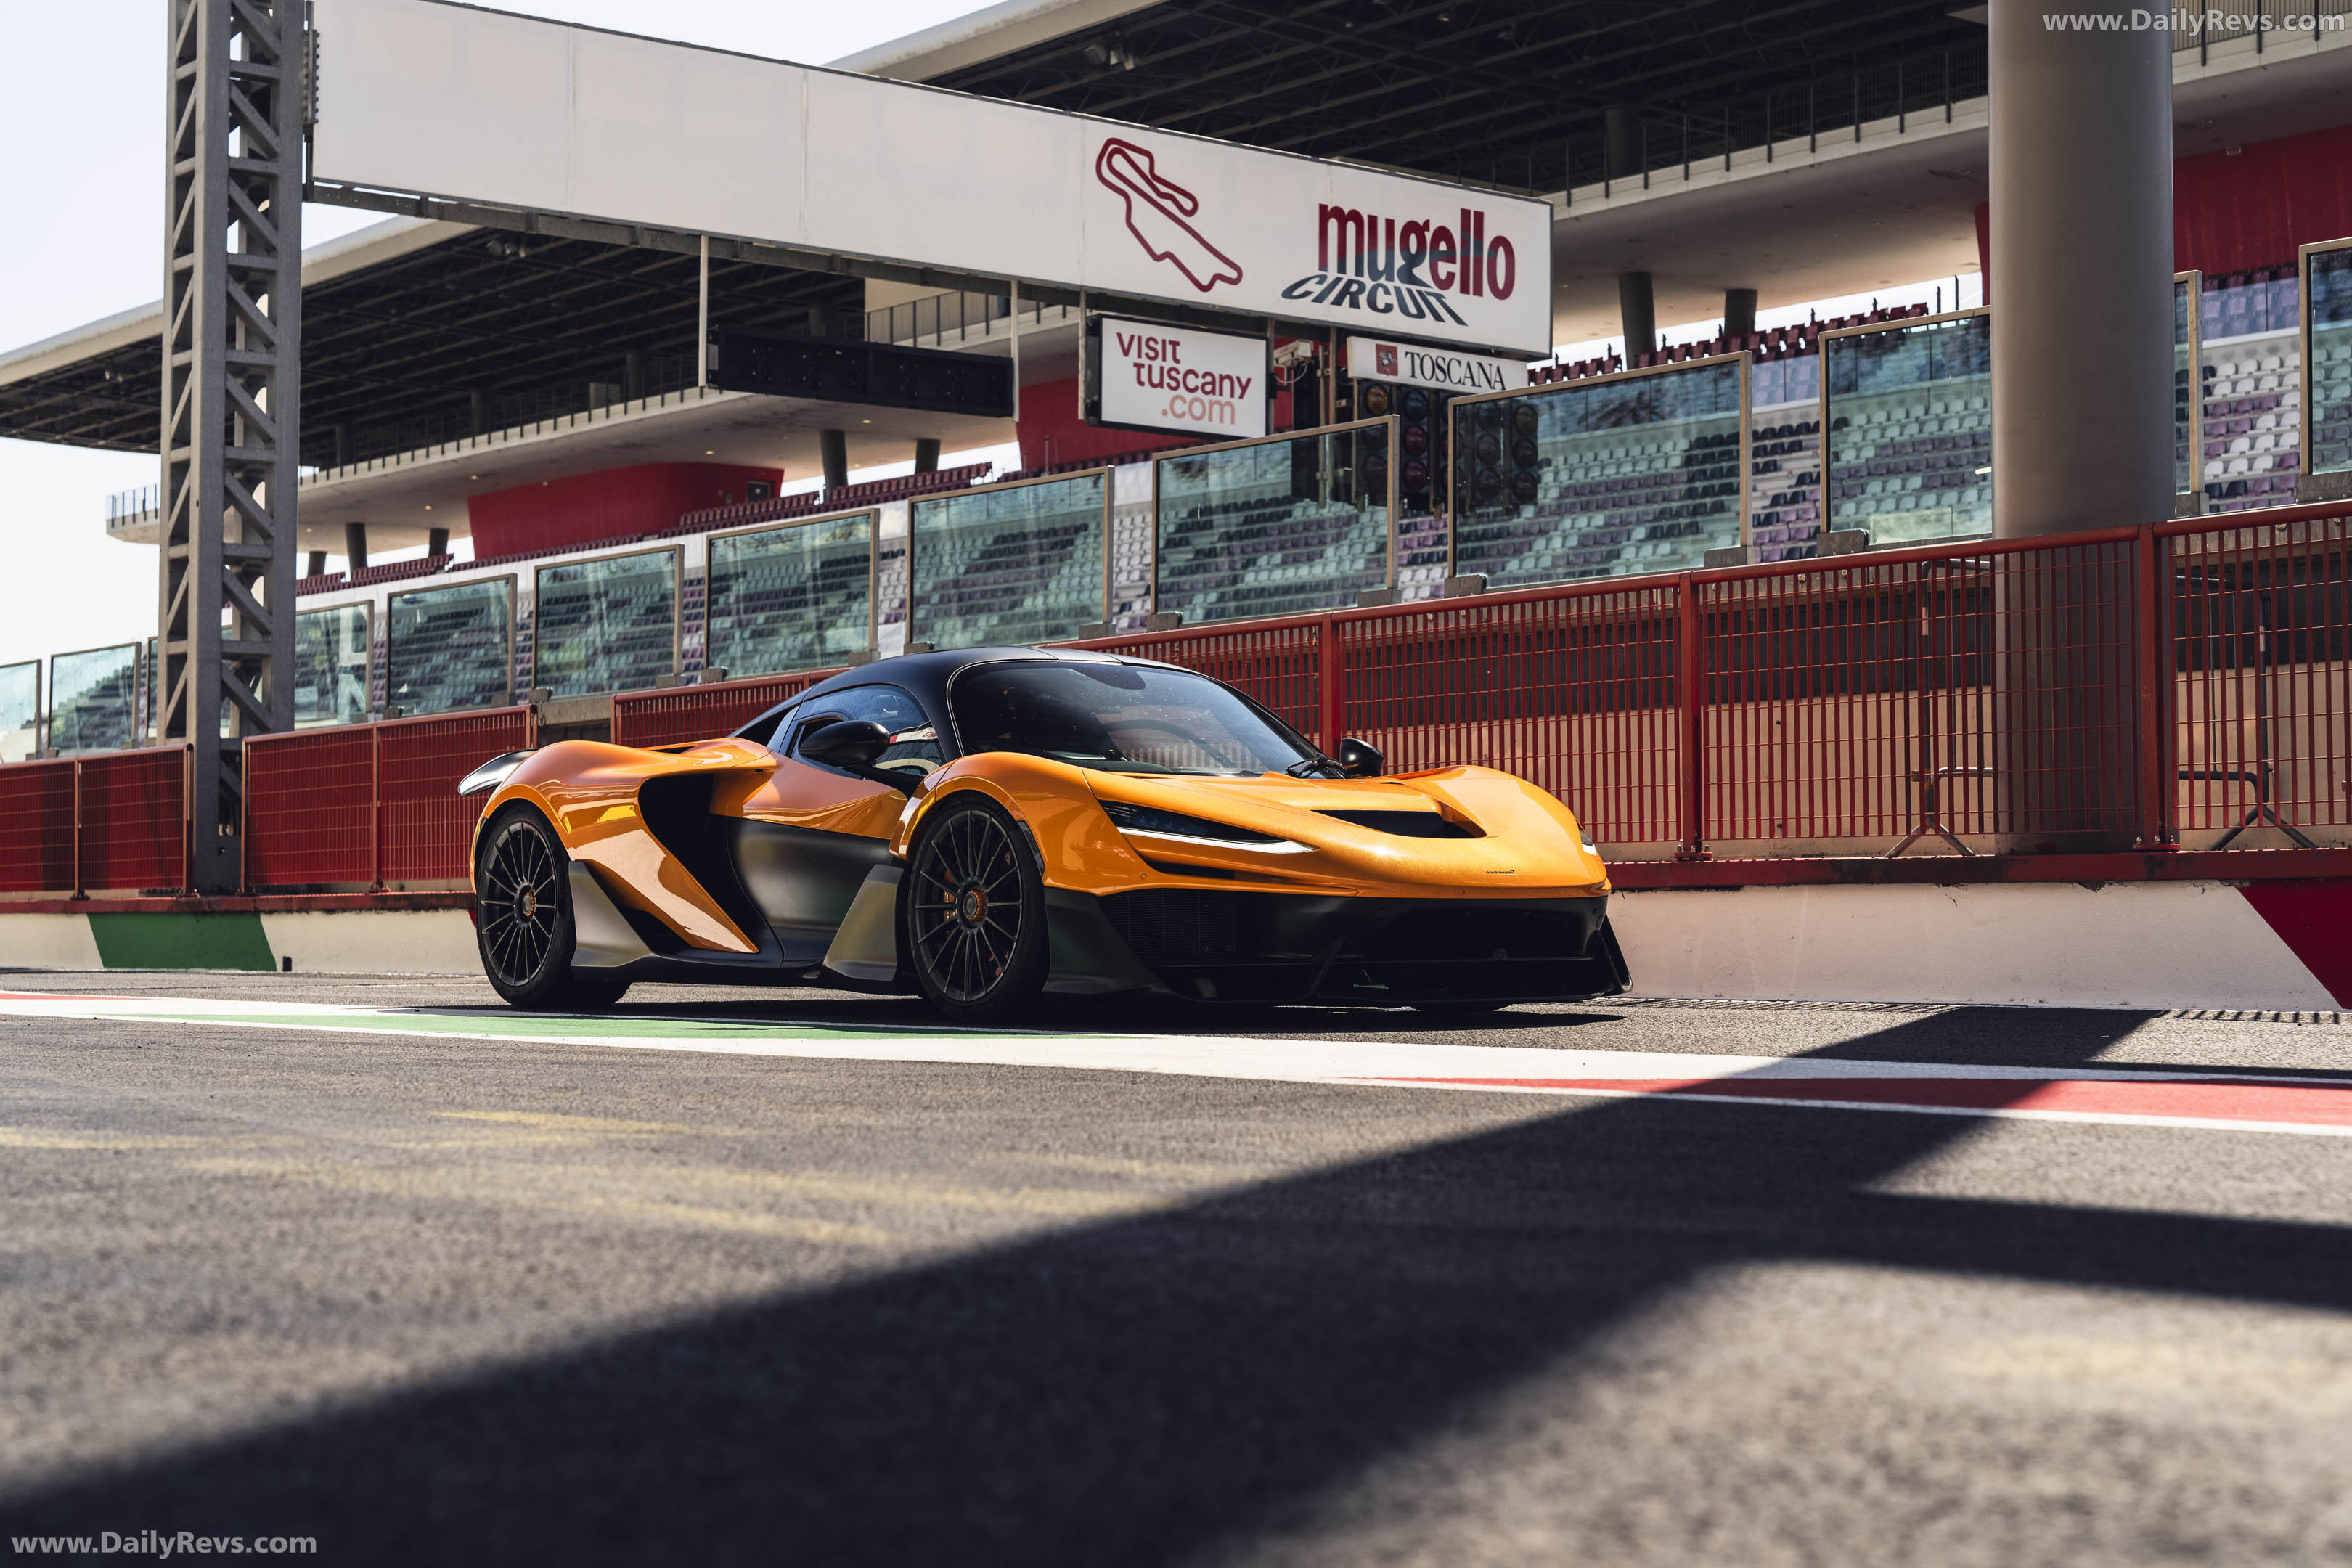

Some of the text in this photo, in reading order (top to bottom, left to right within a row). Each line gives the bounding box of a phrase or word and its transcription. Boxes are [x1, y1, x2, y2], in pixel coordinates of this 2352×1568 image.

[1318, 203, 1516, 301] mugello
[1281, 274, 1468, 326] CIRCUIT
[1116, 332, 1180, 364] VISIT
[1133, 362, 1252, 399] tuscany
[1405, 351, 1507, 391] TOSCANA
[1162, 394, 1235, 425] .com
